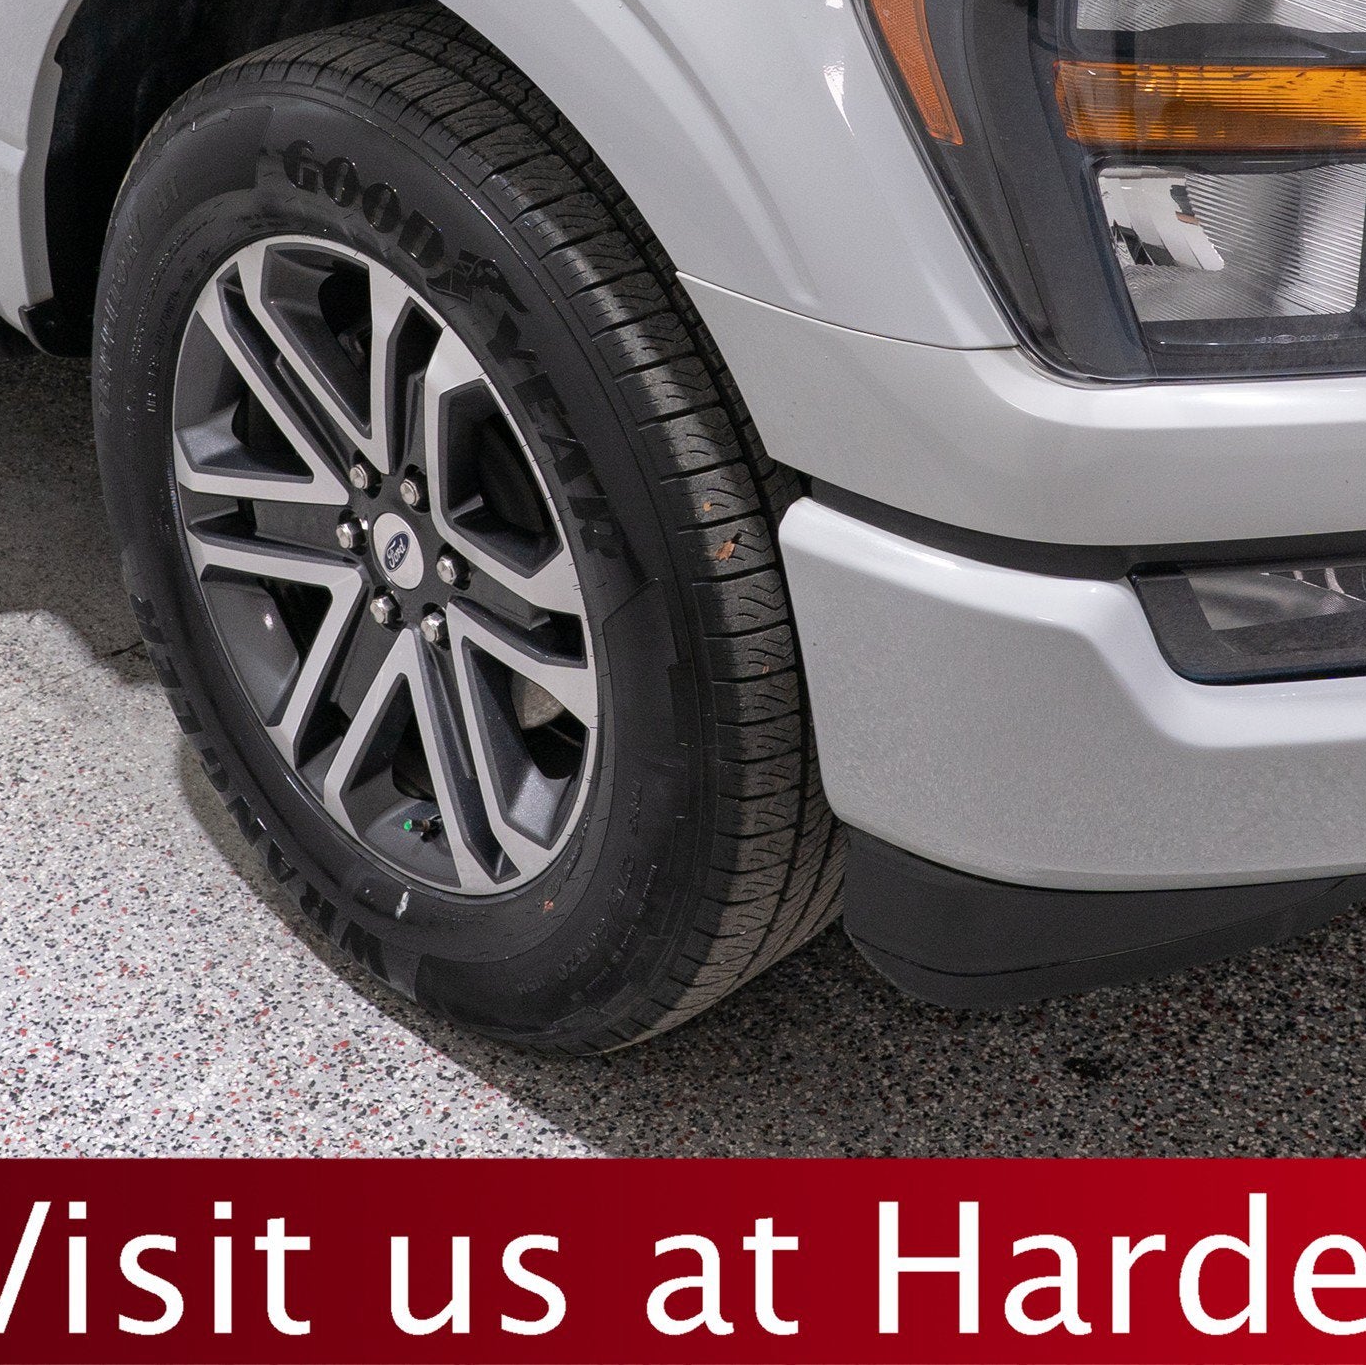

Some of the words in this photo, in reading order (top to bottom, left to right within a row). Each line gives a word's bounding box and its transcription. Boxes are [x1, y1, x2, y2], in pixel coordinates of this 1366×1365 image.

[282, 139, 619, 562] GOODYEAR
[386, 537, 407, 569] Ford
[129, 592, 390, 984] WRANGLER
